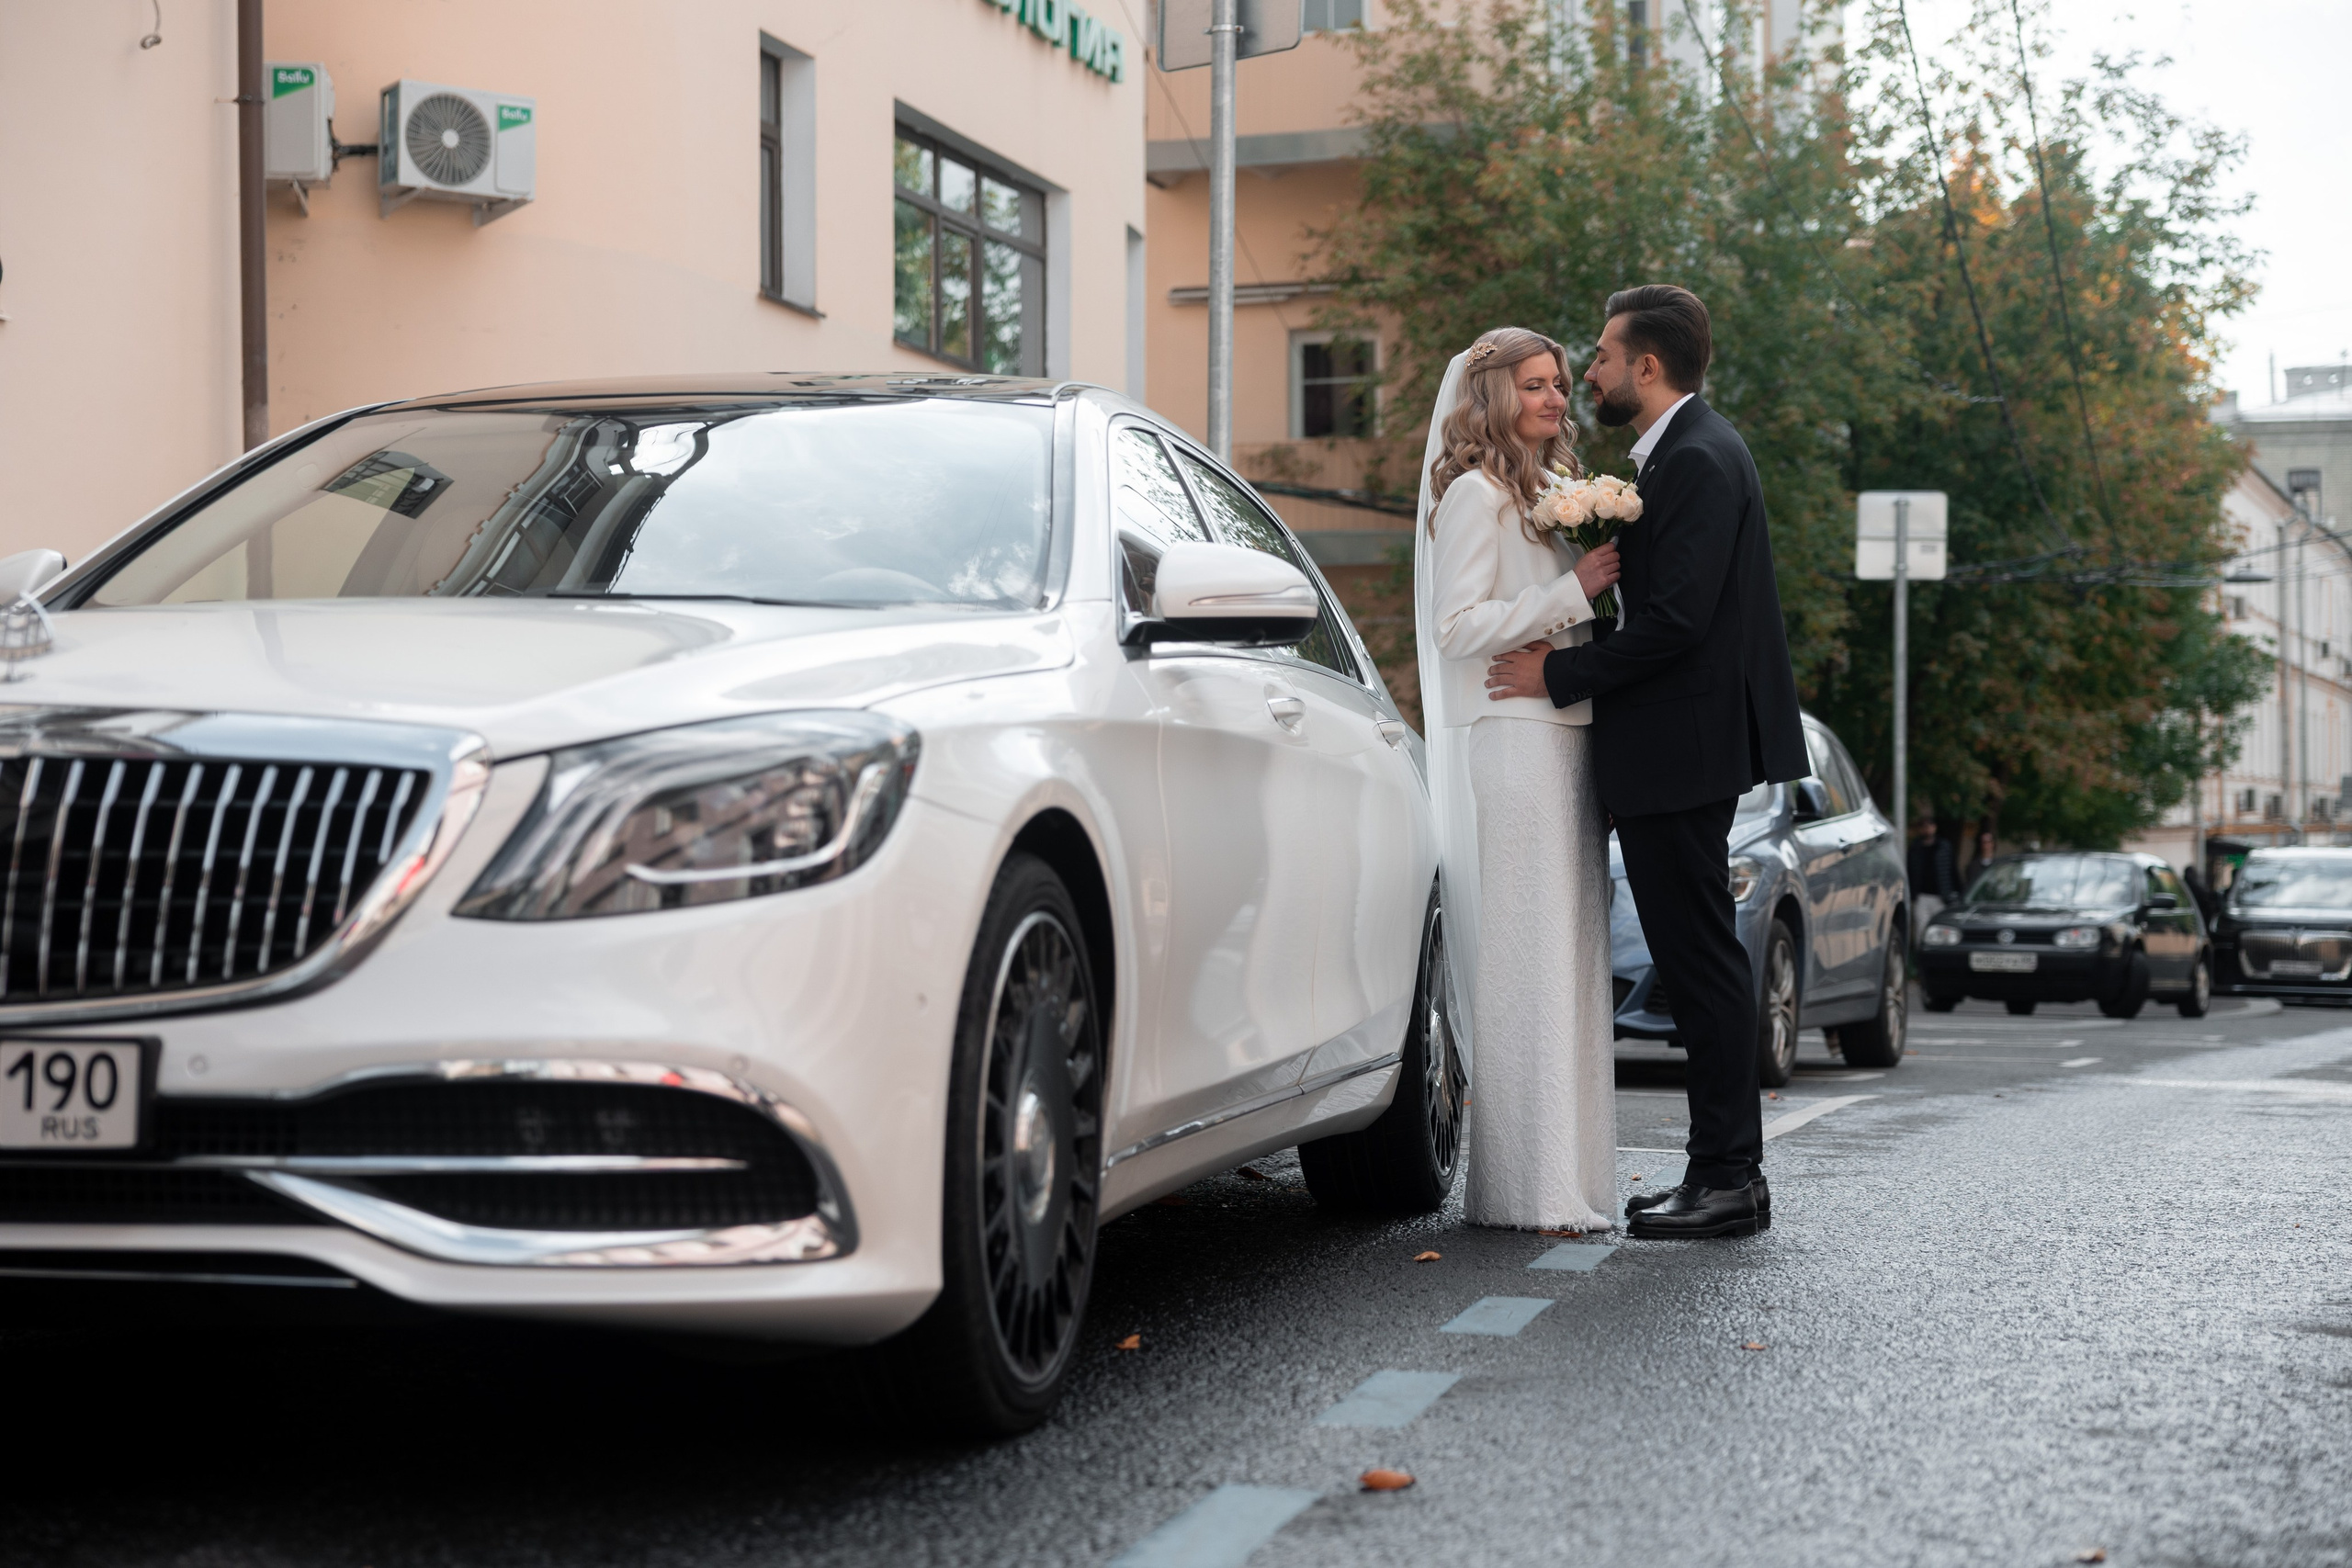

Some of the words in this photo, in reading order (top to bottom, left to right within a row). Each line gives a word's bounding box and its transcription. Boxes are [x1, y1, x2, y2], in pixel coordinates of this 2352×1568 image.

[976, 0, 1125, 84] ОГИЯ
[6, 1051, 119, 1111] 190
[40, 1116, 99, 1140] RUS
